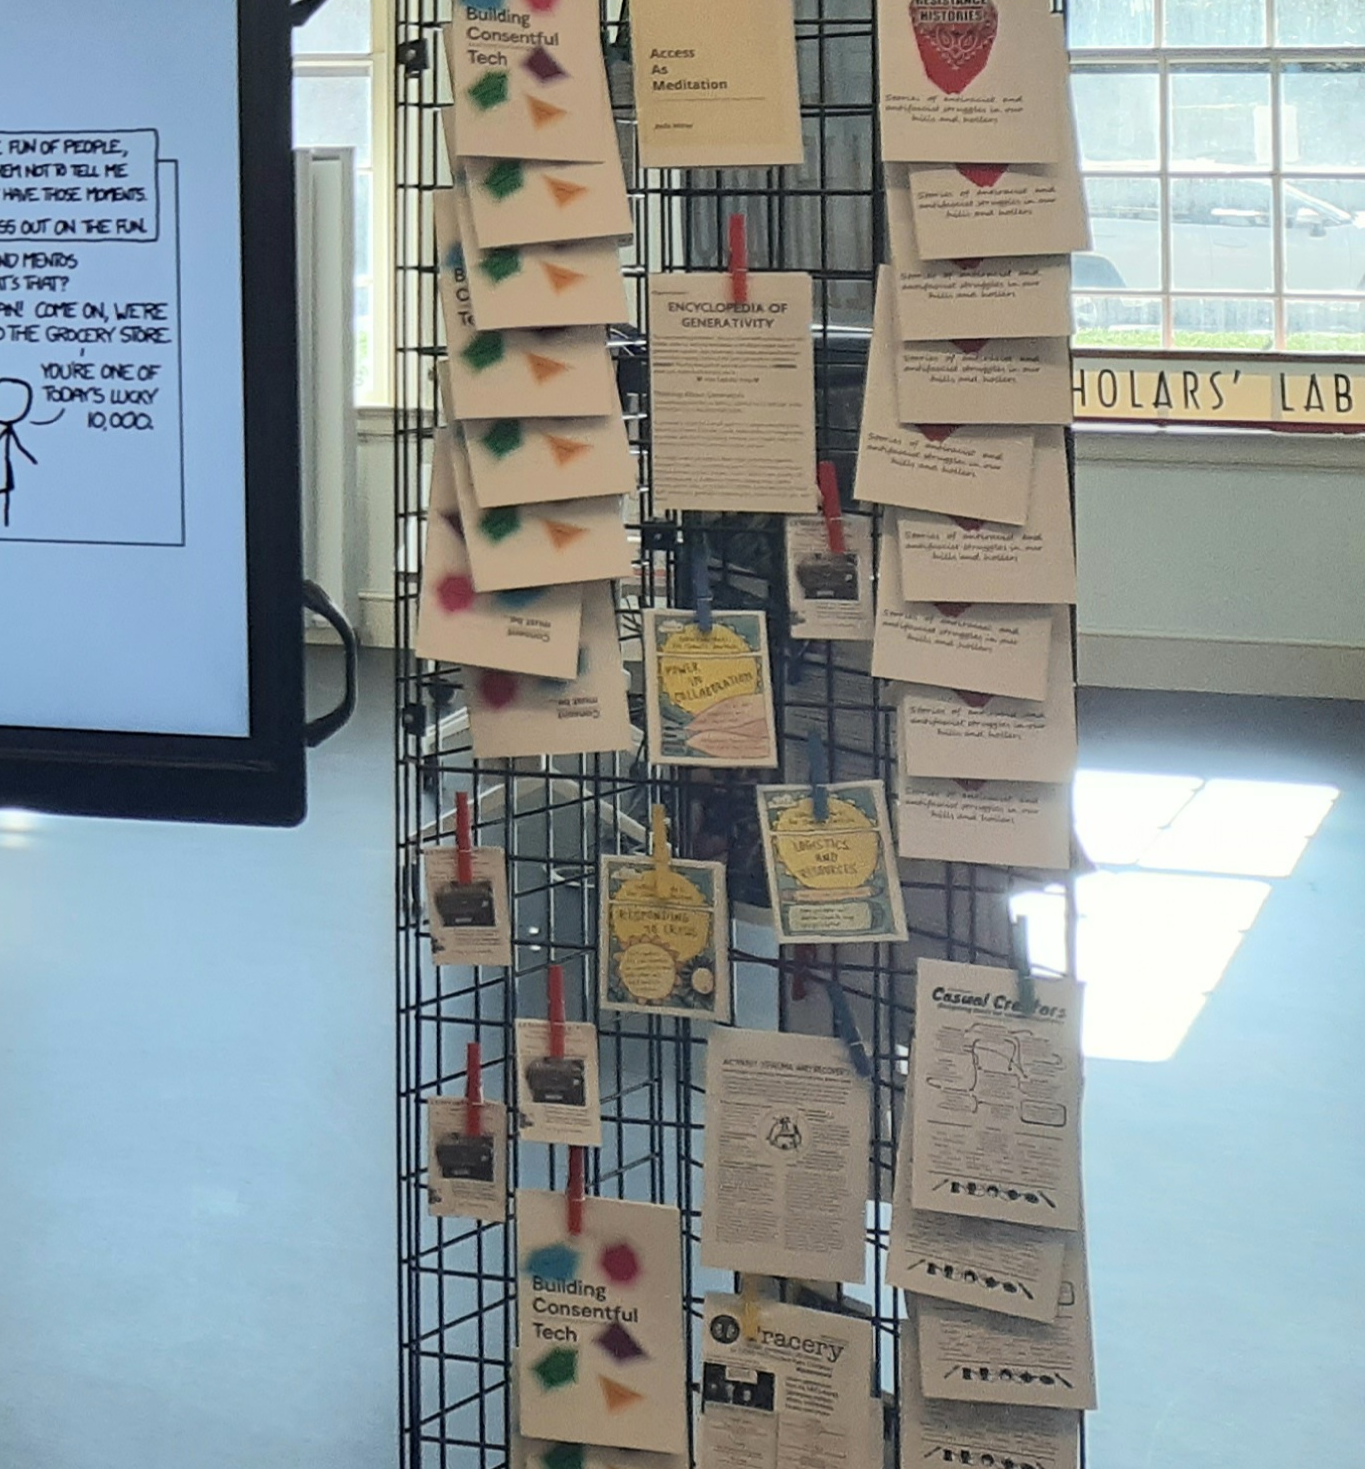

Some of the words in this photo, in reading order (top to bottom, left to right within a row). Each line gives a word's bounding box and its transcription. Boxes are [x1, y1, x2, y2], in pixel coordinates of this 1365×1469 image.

[467, 6, 530, 28] Building
[920, 10, 983, 22] HISTORIES
[467, 26, 559, 46] Consentful
[468, 50, 507, 66] Tech
[650, 48, 695, 59] Access
[651, 64, 668, 75] As
[652, 79, 727, 91] Meditation
[9, 140, 36, 155] FUN
[40, 140, 59, 156] OF
[64, 139, 128, 157] PEOPLE,
[25, 163, 50, 178] NOT
[53, 163, 66, 177] TO
[71, 163, 100, 178] TELL
[105, 163, 128, 178] ME
[3, 187, 37, 202] HAVE
[43, 187, 81, 202] THOSE
[87, 187, 147, 202] MOMENTS.
[21, 218, 51, 234] OUT
[54, 218, 75, 235] ON
[82, 218, 111, 233] THE
[116, 218, 147, 234] FUN.
[668, 302, 764, 314] ENCYCLOPEDIA
[768, 303, 788, 314] OF
[682, 317, 775, 329] GENERATIVITY
[41, 362, 95, 381] YOU'RE
[101, 364, 134, 381] ONE
[136, 364, 161, 381] OF
[42, 385, 105, 405] TODAY'S
[110, 388, 158, 405] LUCKY
[1279, 372, 1354, 413] LAB
[932, 986, 990, 1007] Casual
[532, 1276, 606, 1302] Building
[532, 1298, 638, 1323] Consentful
[532, 1323, 577, 1343] Tech
[756, 1326, 845, 1363] racery
